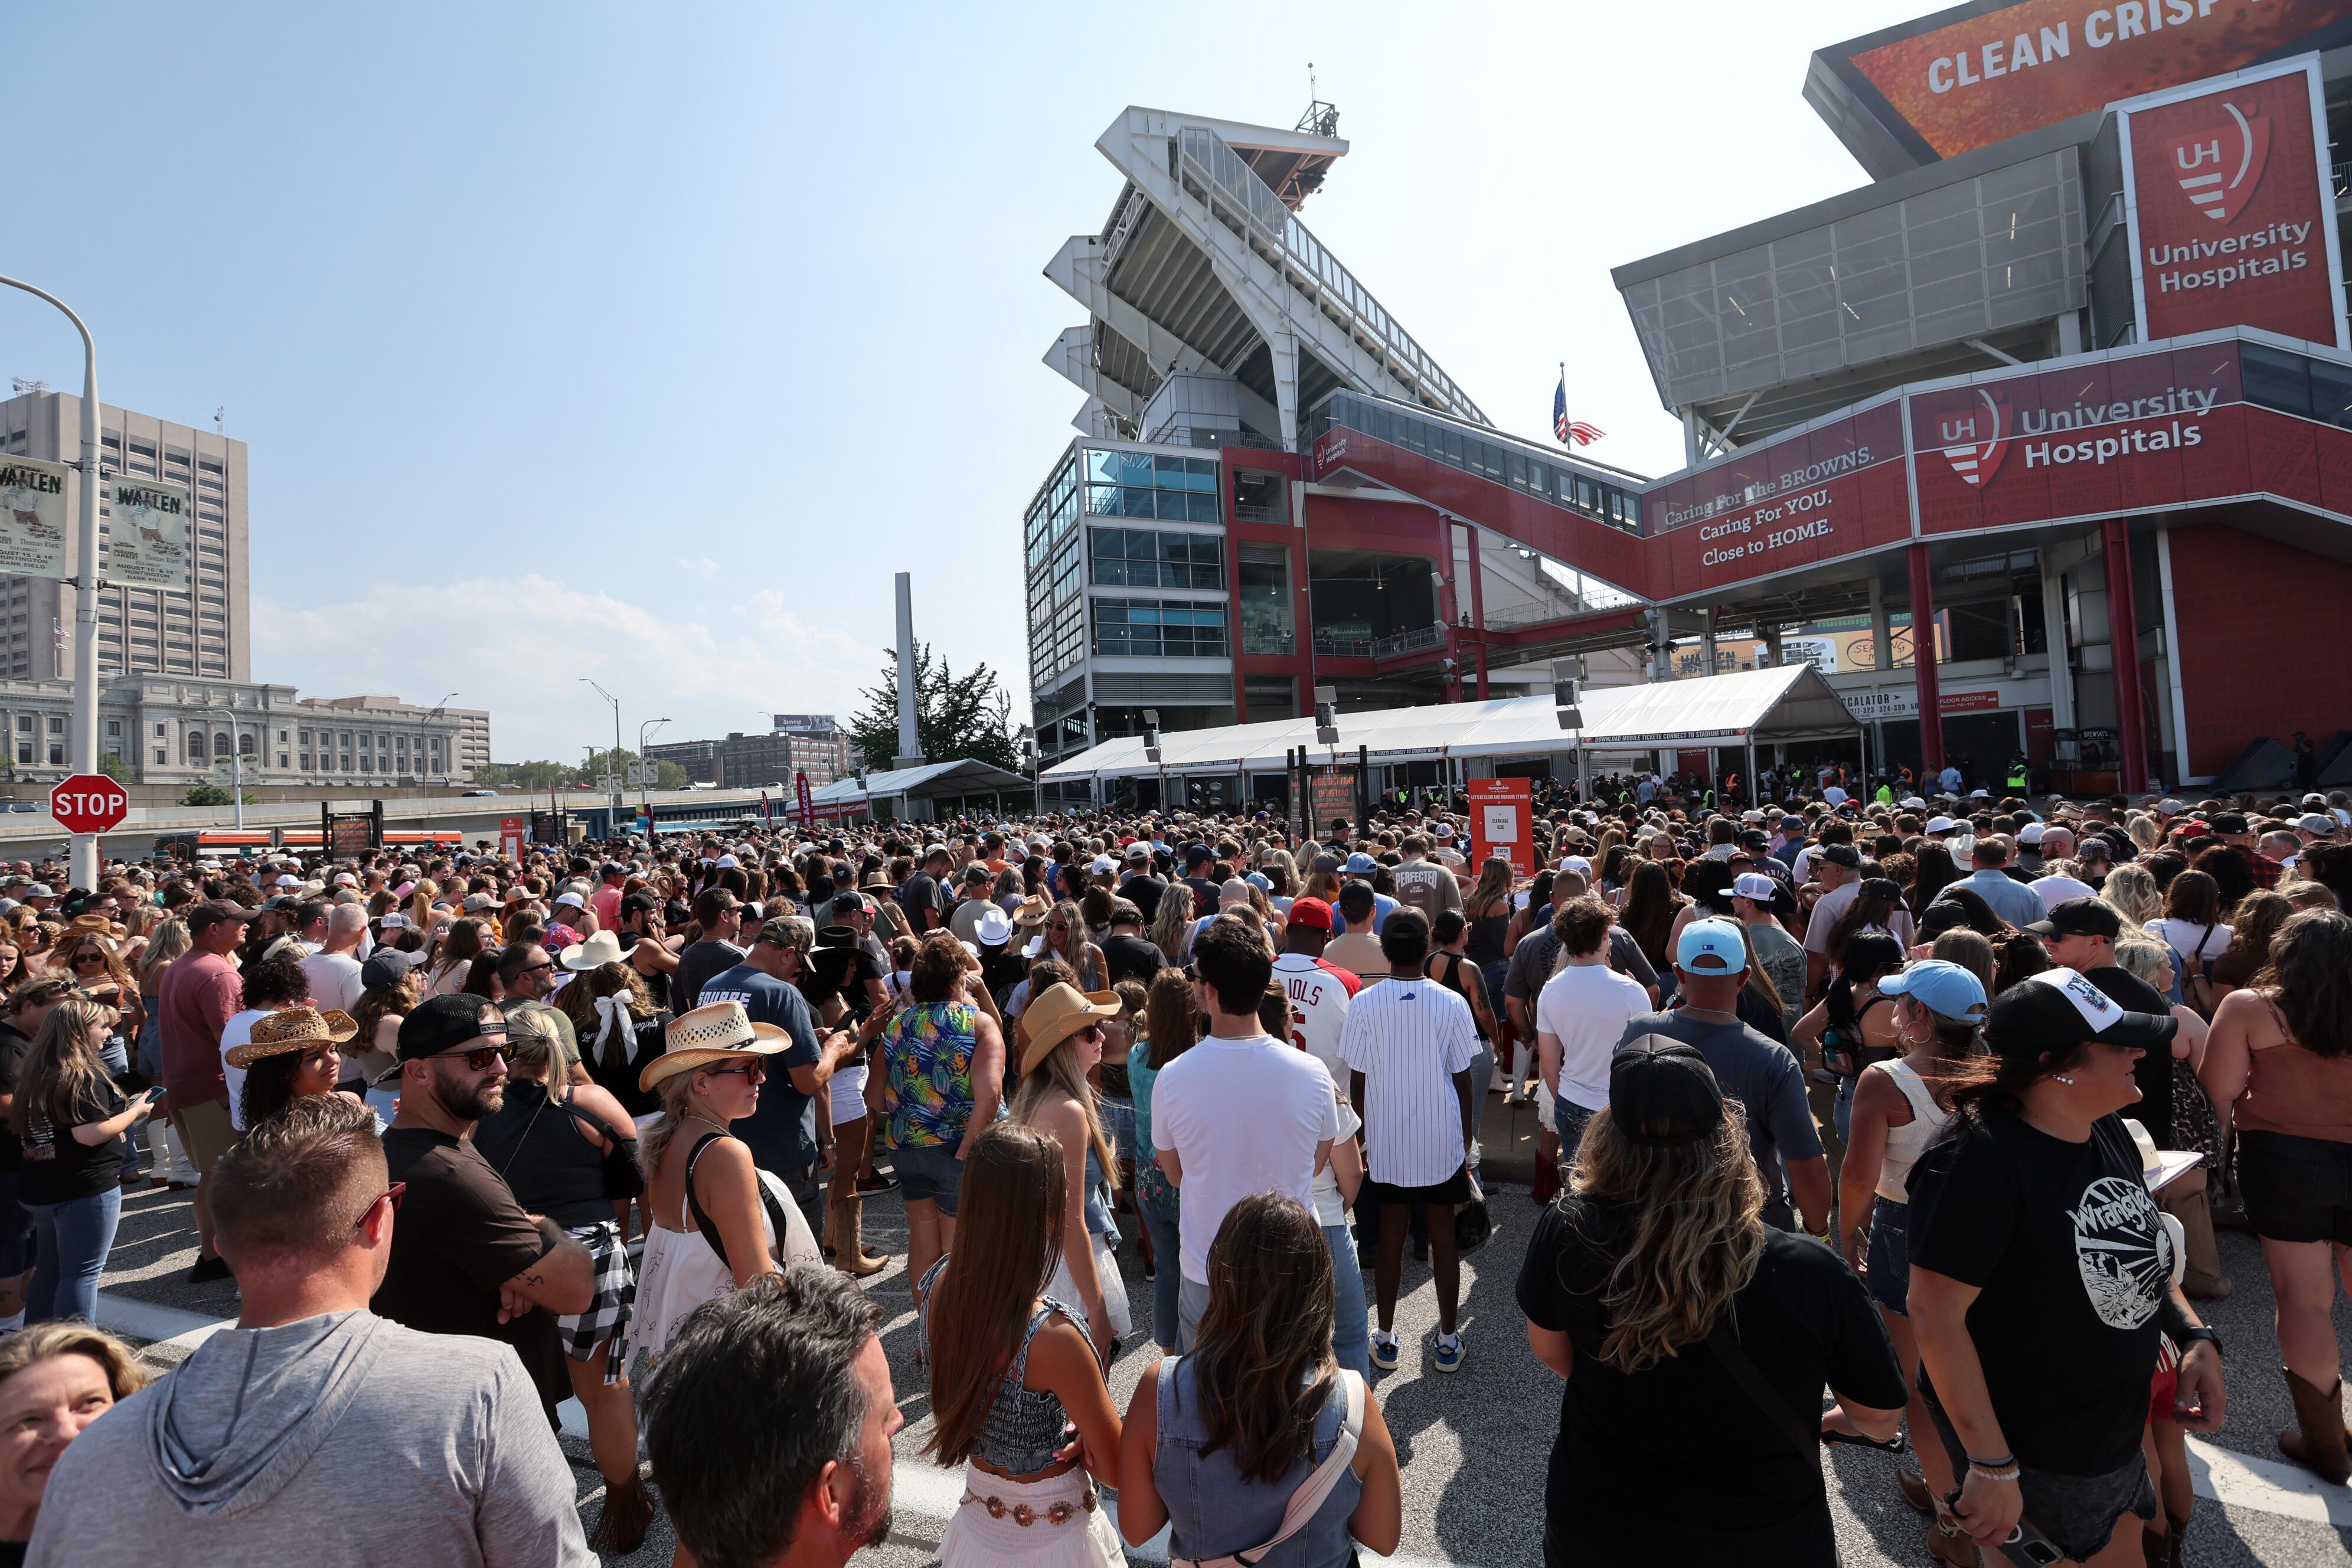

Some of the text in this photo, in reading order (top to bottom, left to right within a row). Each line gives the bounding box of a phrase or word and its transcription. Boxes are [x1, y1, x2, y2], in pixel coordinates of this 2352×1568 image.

[1928, 21, 2070, 94] CLEAN
[2177, 139, 2220, 169] UH
[2149, 221, 2312, 266] University
[2160, 249, 2307, 293] Hospitals
[2021, 387, 2218, 435] University
[1942, 418, 1975, 441] UH
[1325, 438, 1347, 455] University
[1326, 447, 1345, 463] Hospitals
[2024, 421, 2201, 468] Hospitals
[1665, 446, 1875, 526] Caring For The BROWNS.
[1700, 489, 1832, 541] Caring For YOU.
[20, 538, 43, 547] Thomas
[1703, 518, 1834, 566] Close to HOME.
[0, 554, 48, 564] HUNTINGTON
[145, 554, 165, 562] Thomas
[125, 570, 170, 579] HUNTINGTON
[1854, 641, 1905, 653] SEANG
[1842, 694, 1889, 707] SCALATOR
[1879, 704, 1906, 712] 324-339
[1340, 776, 1354, 785] FANS
[55, 793, 124, 816] STOP
[801, 780, 809, 815] ACCESS
[1395, 870, 1438, 893] PERFECTED
[1765, 869, 1789, 883] NNING
[1540, 936, 1559, 971] HARLE
[697, 991, 752, 1010] SQUARE
[1288, 978, 1323, 1007] JOLS
[633, 1020, 659, 1033] wgirls
